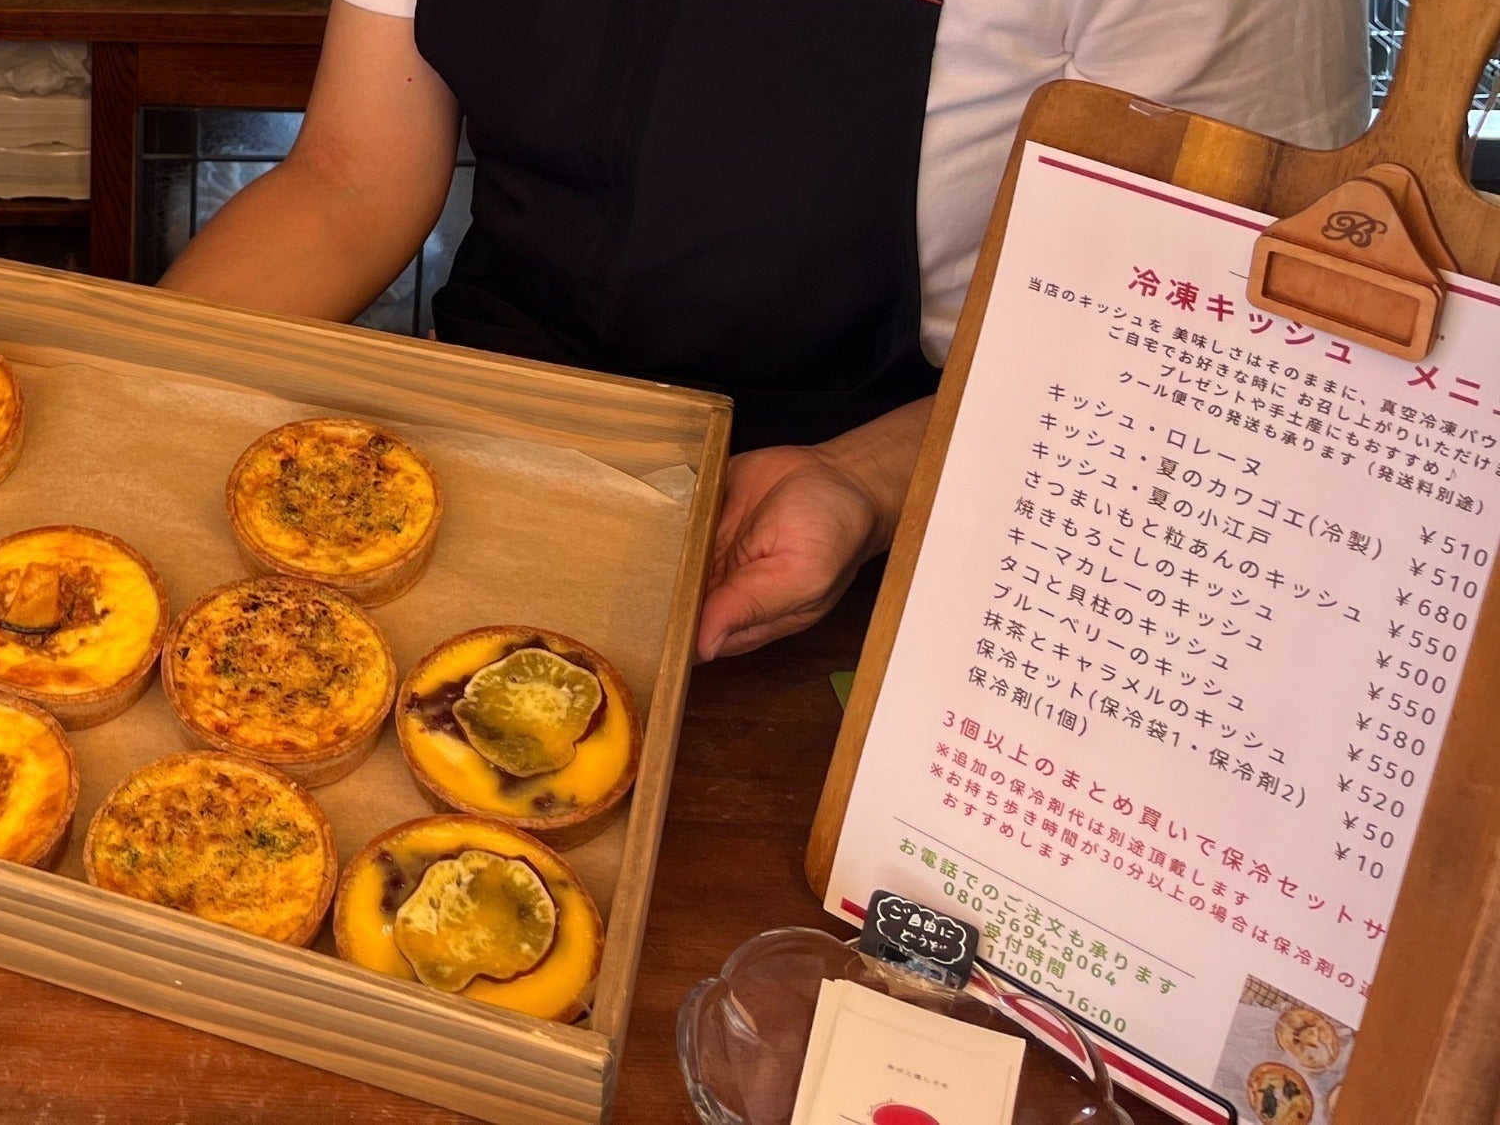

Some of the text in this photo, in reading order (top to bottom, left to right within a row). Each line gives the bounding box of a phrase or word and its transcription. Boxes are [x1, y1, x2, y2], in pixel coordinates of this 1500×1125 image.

[1028, 277, 1163, 334] 当店のキッシュを
[1128, 265, 1500, 416] 冷凍キッシュ メニ
[1108, 325, 1287, 398] ご自宅でお好きな時に
[1048, 383, 1264, 477] キッシュ・ロレーヌ
[1032, 441, 1272, 546] キッシュ・夏の小江戸
[1007, 526, 1265, 651] キーマカレーのキッシュ
[1014, 496, 1274, 622] 焼きもろこしのキッシュ
[1024, 470, 1362, 623] さつまいもと粒あんのキッシュ
[994, 583, 1245, 712] ブルーベリーのキッシュ
[1001, 555, 1229, 670] タコと貝柱のキッシュ
[968, 666, 1089, 737] 保冷剤(1個)
[983, 609, 1287, 764] 抹茶とキャラメルのキッシュ
[943, 793, 1075, 868] おすすめします
[889, 905, 955, 938] ご自由に
[899, 837, 1178, 996] お電話でのご注文も承ります
[900, 929, 947, 953] どうぞ
[943, 881, 1118, 987] 080-5694-8064
[983, 921, 1067, 980] 受付時間
